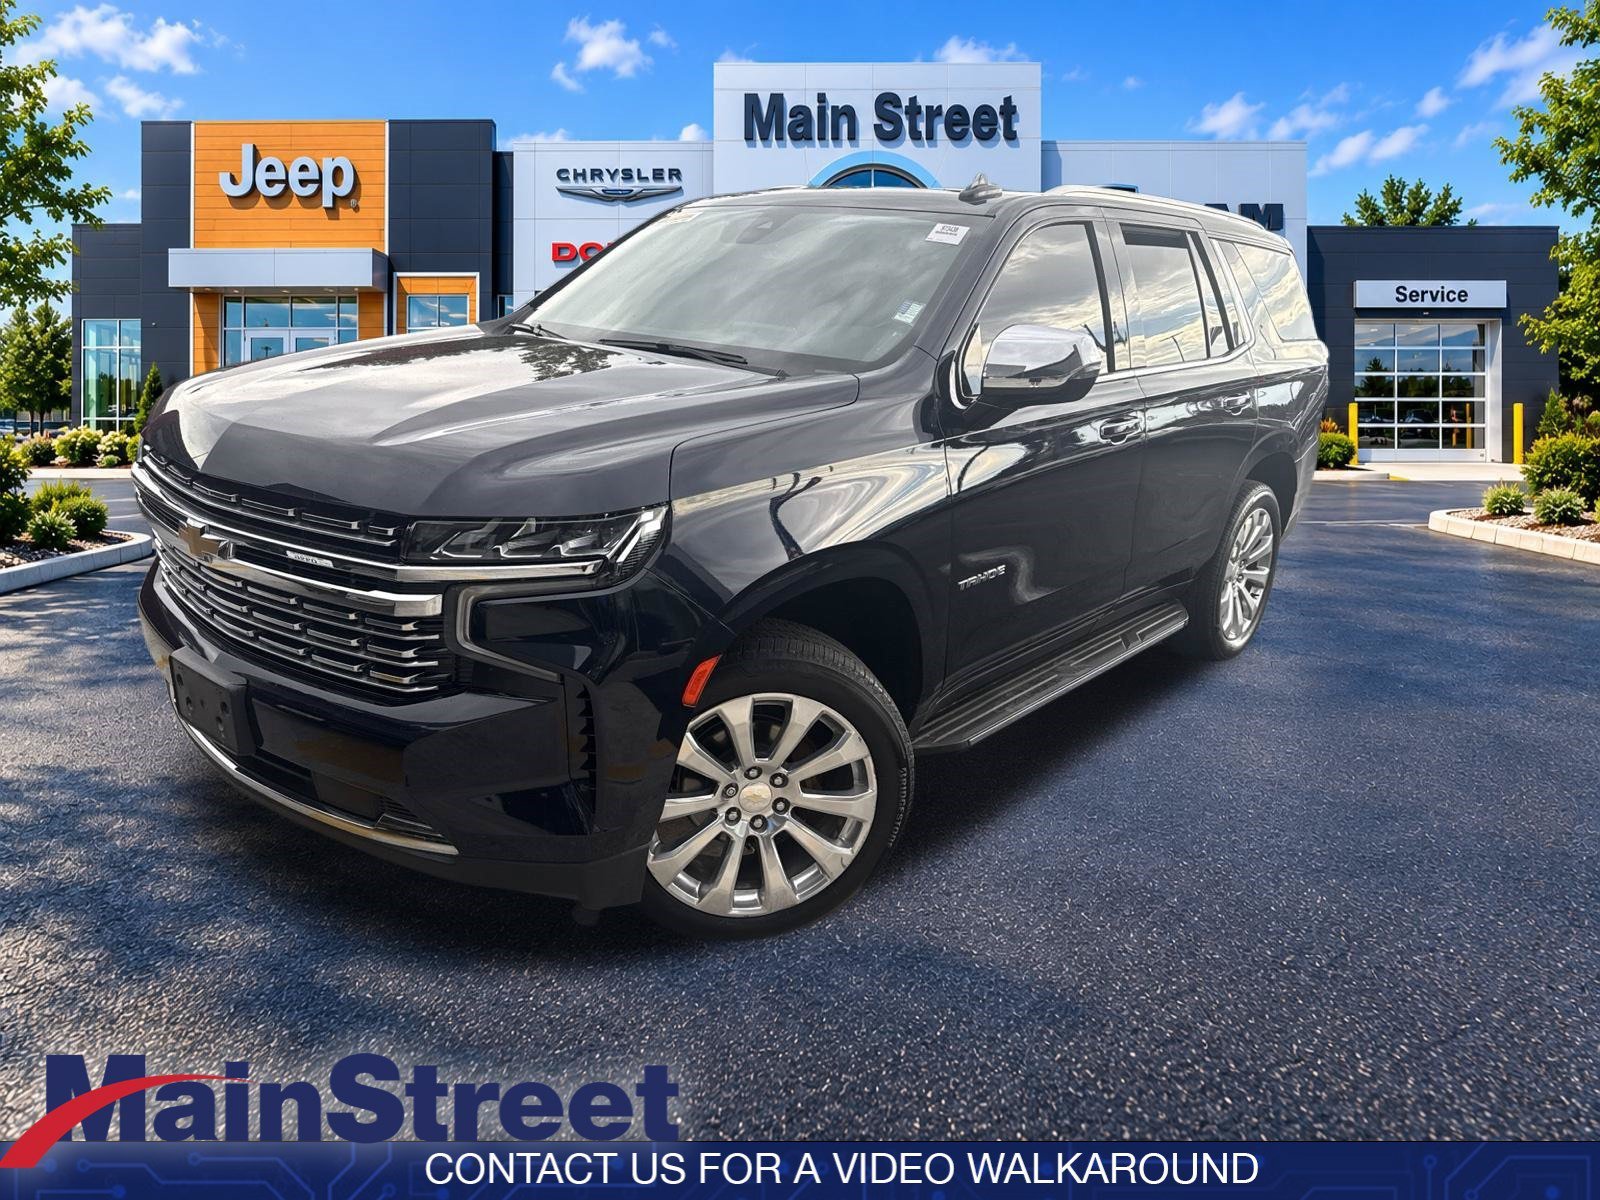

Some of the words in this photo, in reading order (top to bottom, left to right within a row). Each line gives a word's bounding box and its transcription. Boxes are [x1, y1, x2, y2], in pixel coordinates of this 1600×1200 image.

[743, 92, 857, 142] Main
[873, 91, 1018, 142] Street
[218, 143, 354, 208] Jeep
[556, 168, 682, 182] CHRYSLER
[1204, 203, 1284, 231] M
[551, 241, 614, 263] DO
[1395, 285, 1469, 303] Service
[957, 564, 1007, 591] TAHOE
